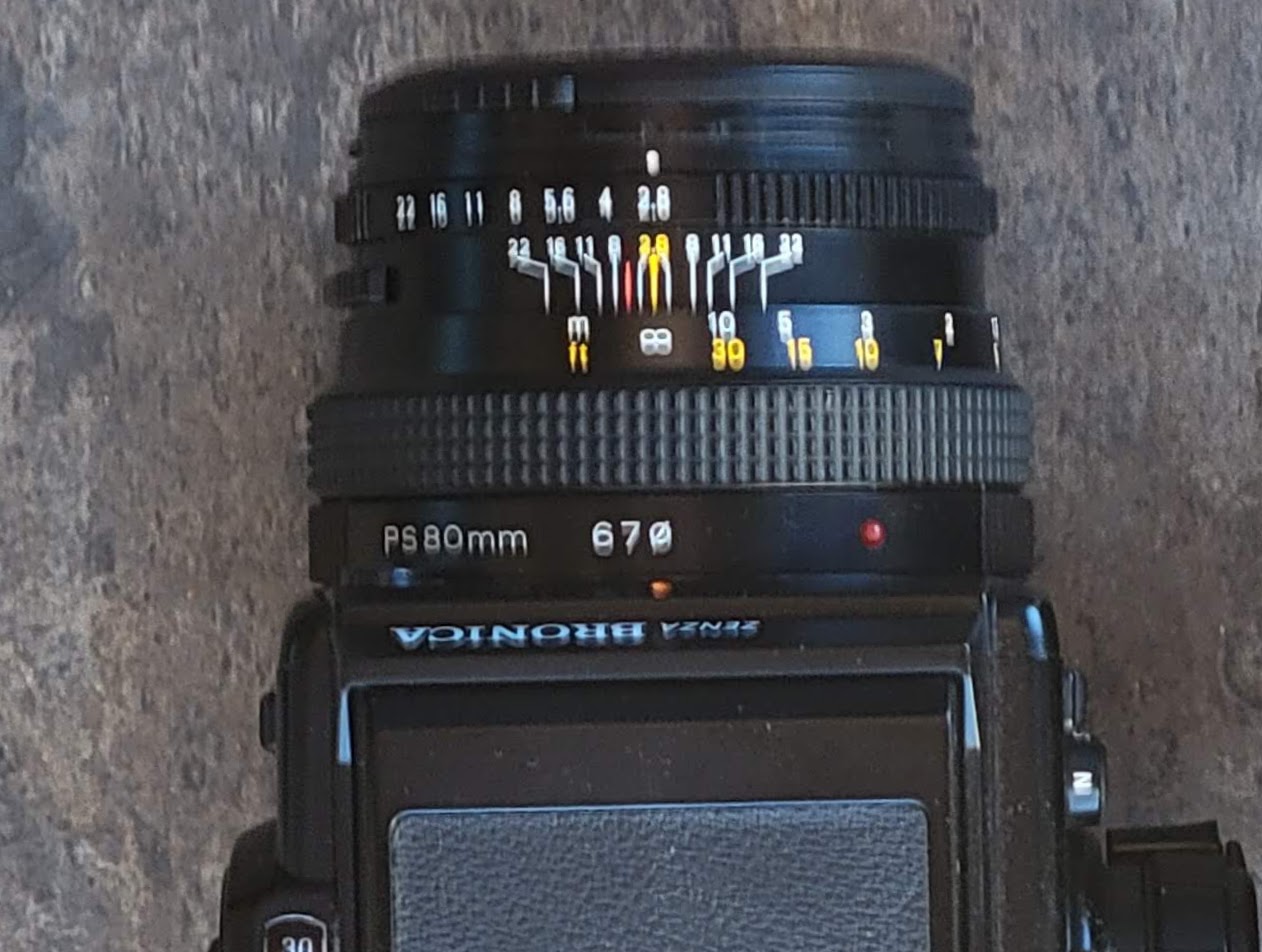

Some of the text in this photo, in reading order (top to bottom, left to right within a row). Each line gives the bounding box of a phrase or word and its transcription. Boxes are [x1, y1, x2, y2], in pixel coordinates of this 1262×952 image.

[430, 191, 448, 228] 16
[465, 190, 484, 227] 11
[598, 186, 612, 222] 4
[707, 311, 736, 340] 10
[711, 337, 745, 372] 30
[787, 337, 812, 371] 15
[855, 337, 879, 372] 10
[388, 621, 648, 650] BRONICA
